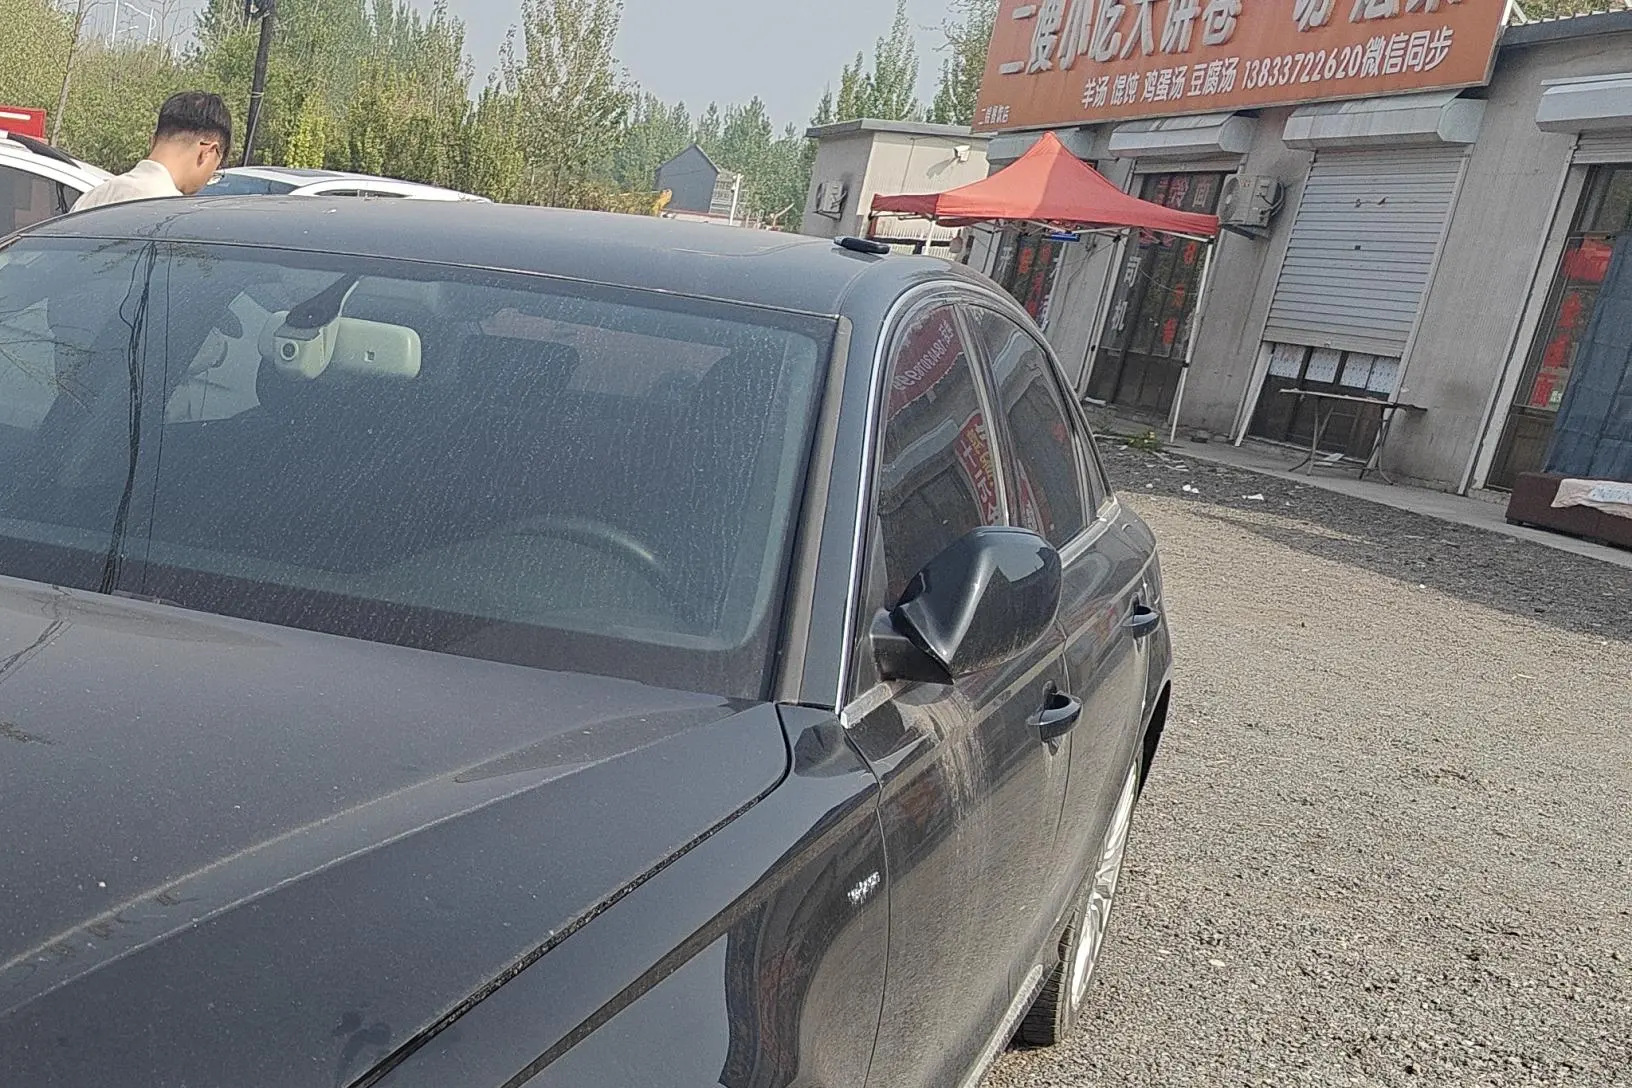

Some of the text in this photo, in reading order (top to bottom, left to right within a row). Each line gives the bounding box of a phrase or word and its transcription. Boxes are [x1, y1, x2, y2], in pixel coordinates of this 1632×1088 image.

[1081, 76, 1110, 109] 羊汤
[1140, 65, 1188, 103] 鸡蛋汤
[1187, 56, 1240, 97] 豆腐汤
